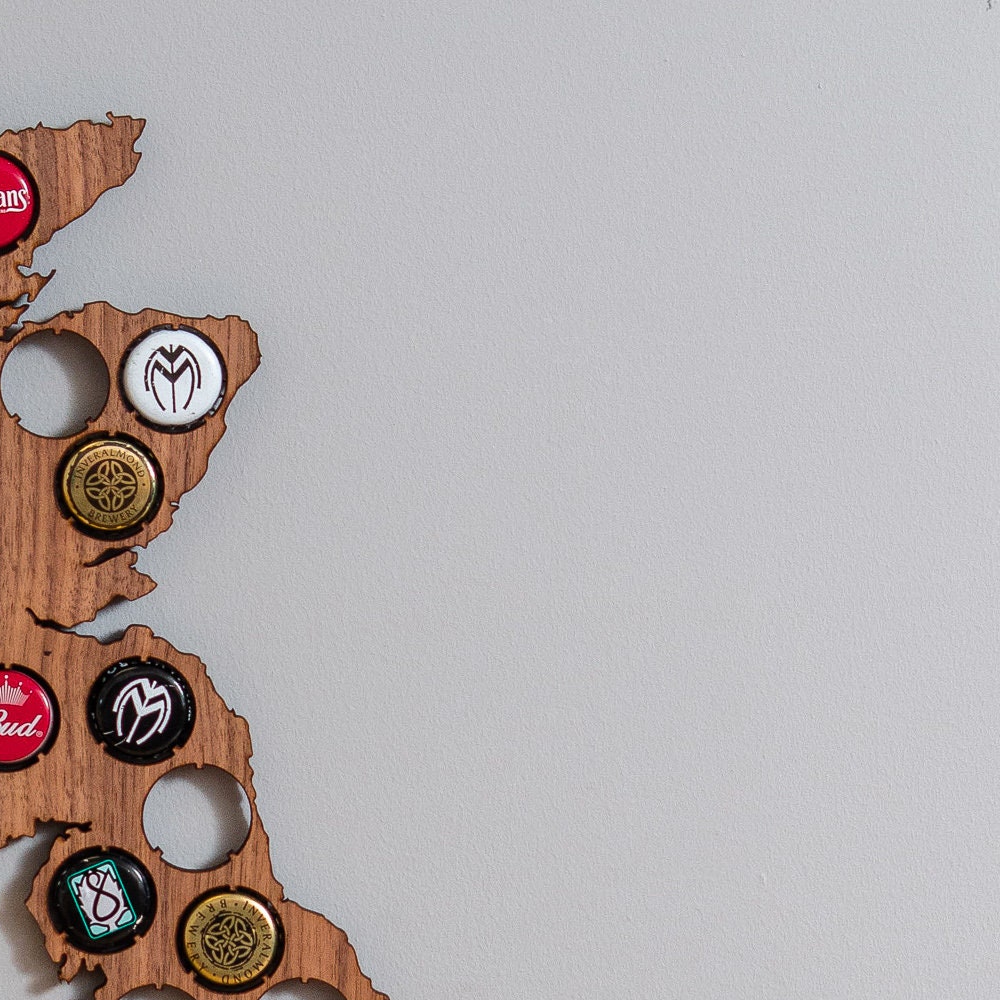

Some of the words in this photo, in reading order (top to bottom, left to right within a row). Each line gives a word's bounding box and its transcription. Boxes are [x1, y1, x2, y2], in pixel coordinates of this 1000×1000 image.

[74, 448, 145, 480] INVERALMOND
[88, 504, 139, 523] BREWERY
[186, 899, 228, 971] BREWERY
[221, 900, 273, 984] INVERALMOND
